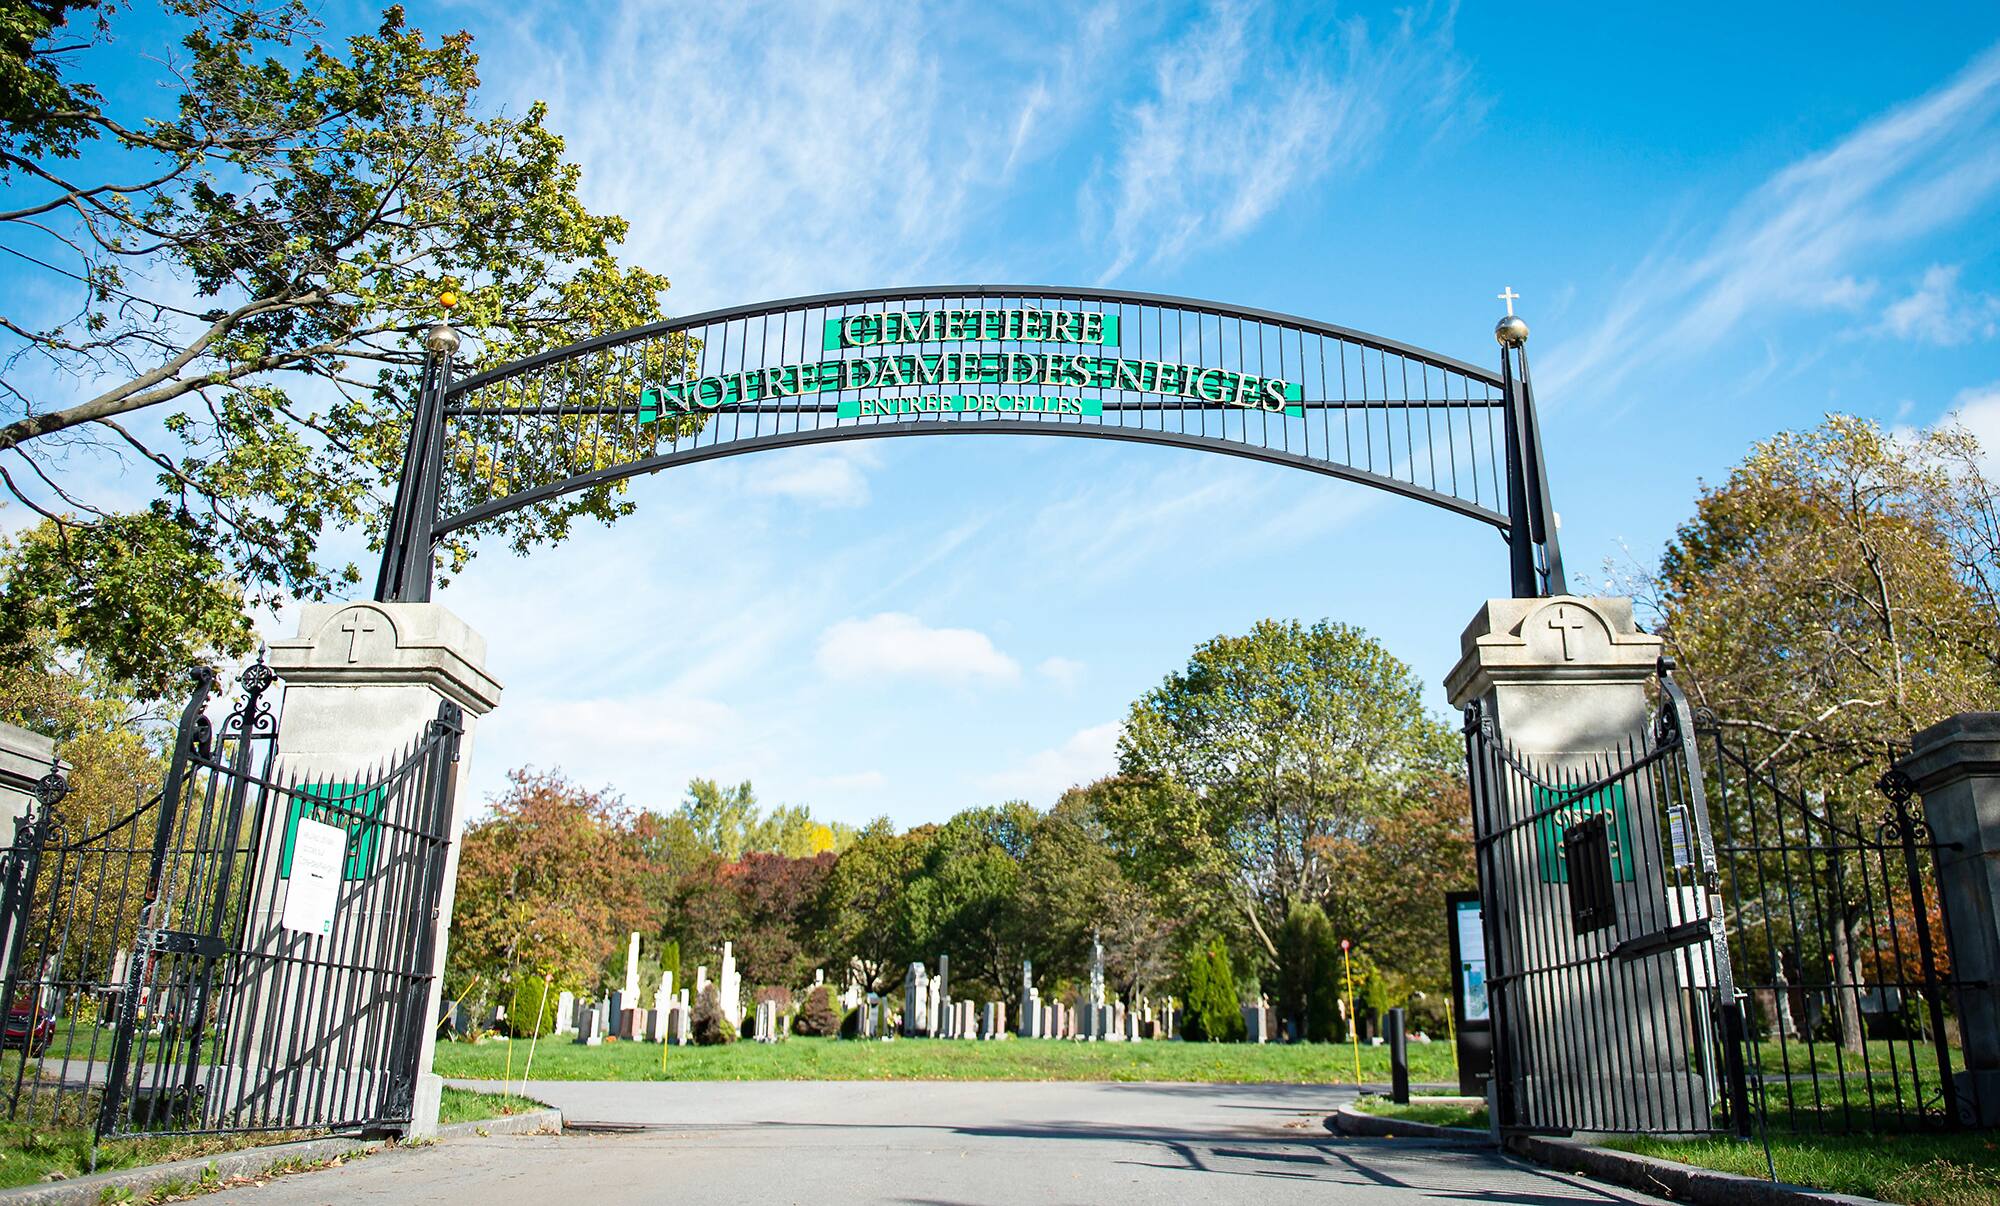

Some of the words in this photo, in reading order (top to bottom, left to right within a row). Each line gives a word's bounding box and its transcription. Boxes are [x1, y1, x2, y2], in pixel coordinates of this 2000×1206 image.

[844, 302, 1105, 347] CIMETIÈRE
[655, 350, 1288, 418] NOTRE-DAME-DES-NEIGES
[859, 392, 953, 416] ENTRÉE
[963, 394, 1083, 415] DECELLES
